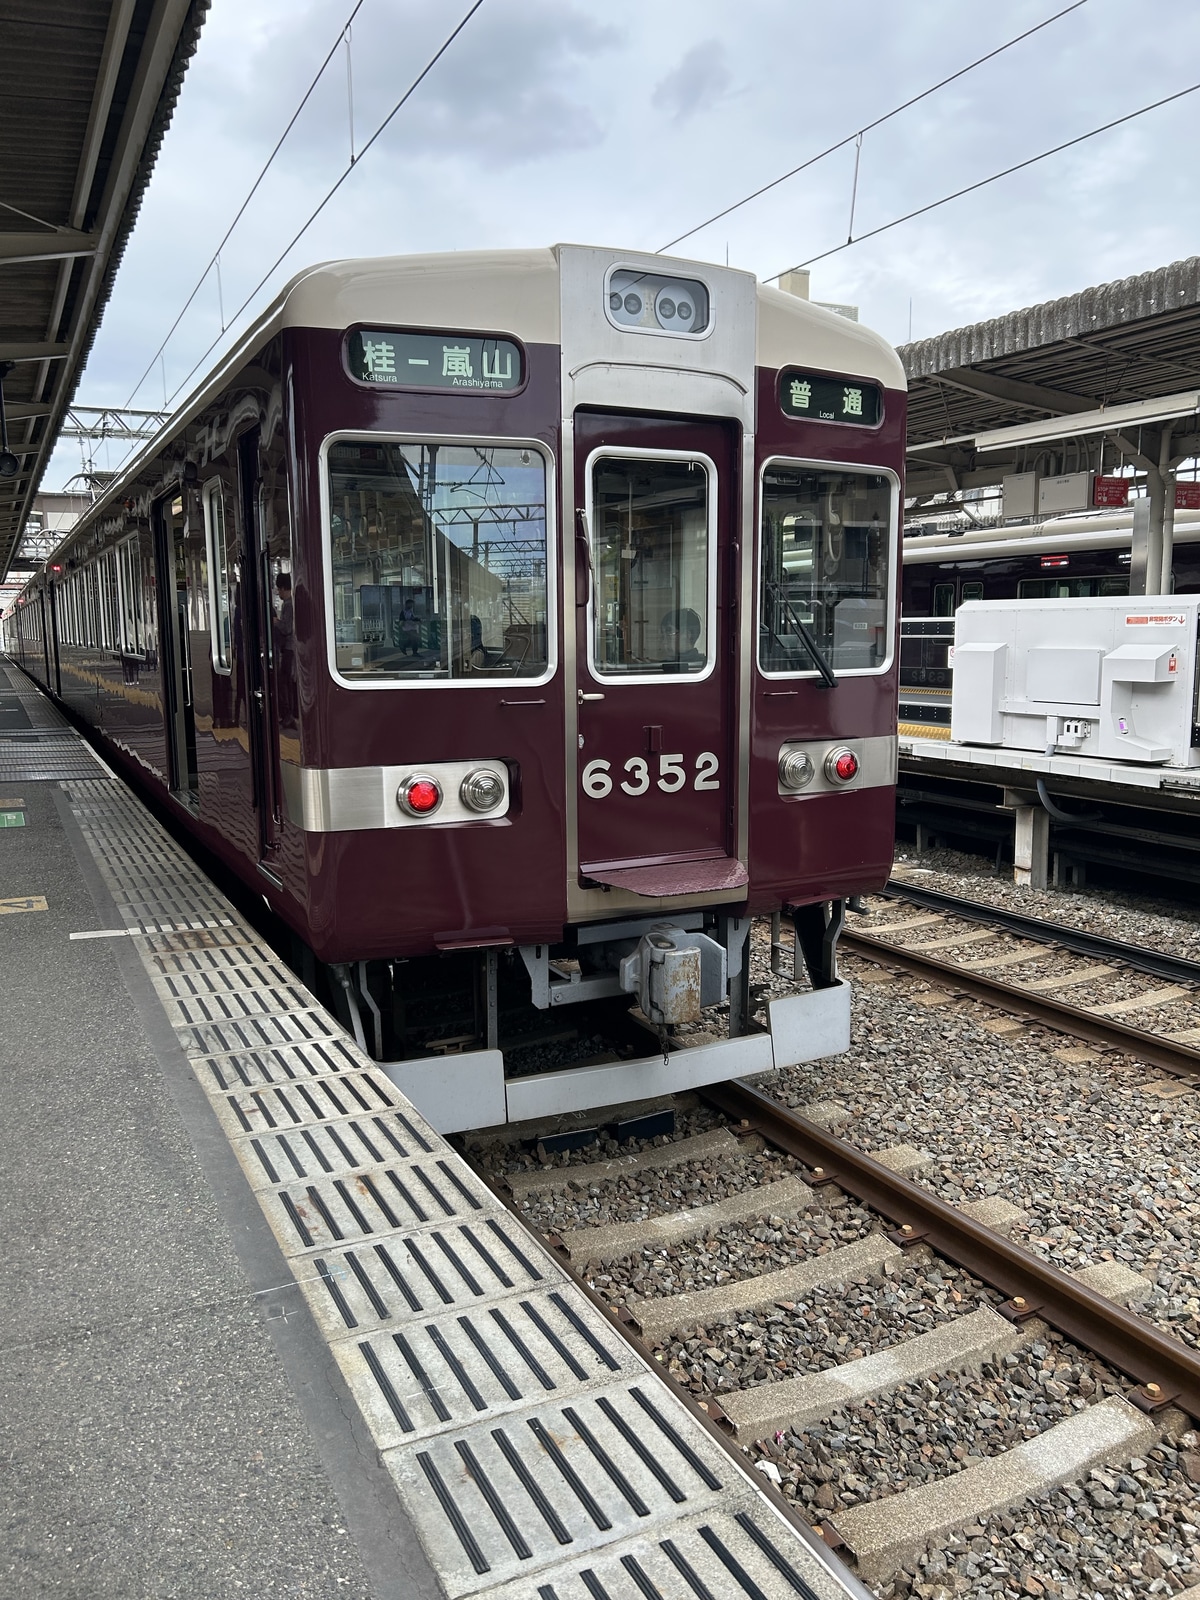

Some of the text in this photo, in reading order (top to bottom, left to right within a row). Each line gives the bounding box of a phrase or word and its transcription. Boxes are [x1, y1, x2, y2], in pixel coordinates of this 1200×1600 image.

[362, 372, 398, 383] Katsura
[452, 377, 503, 388] Arashiyama
[790, 379, 863, 415] 普通
[819, 410, 835, 419] Local
[582, 751, 720, 799] 6352
